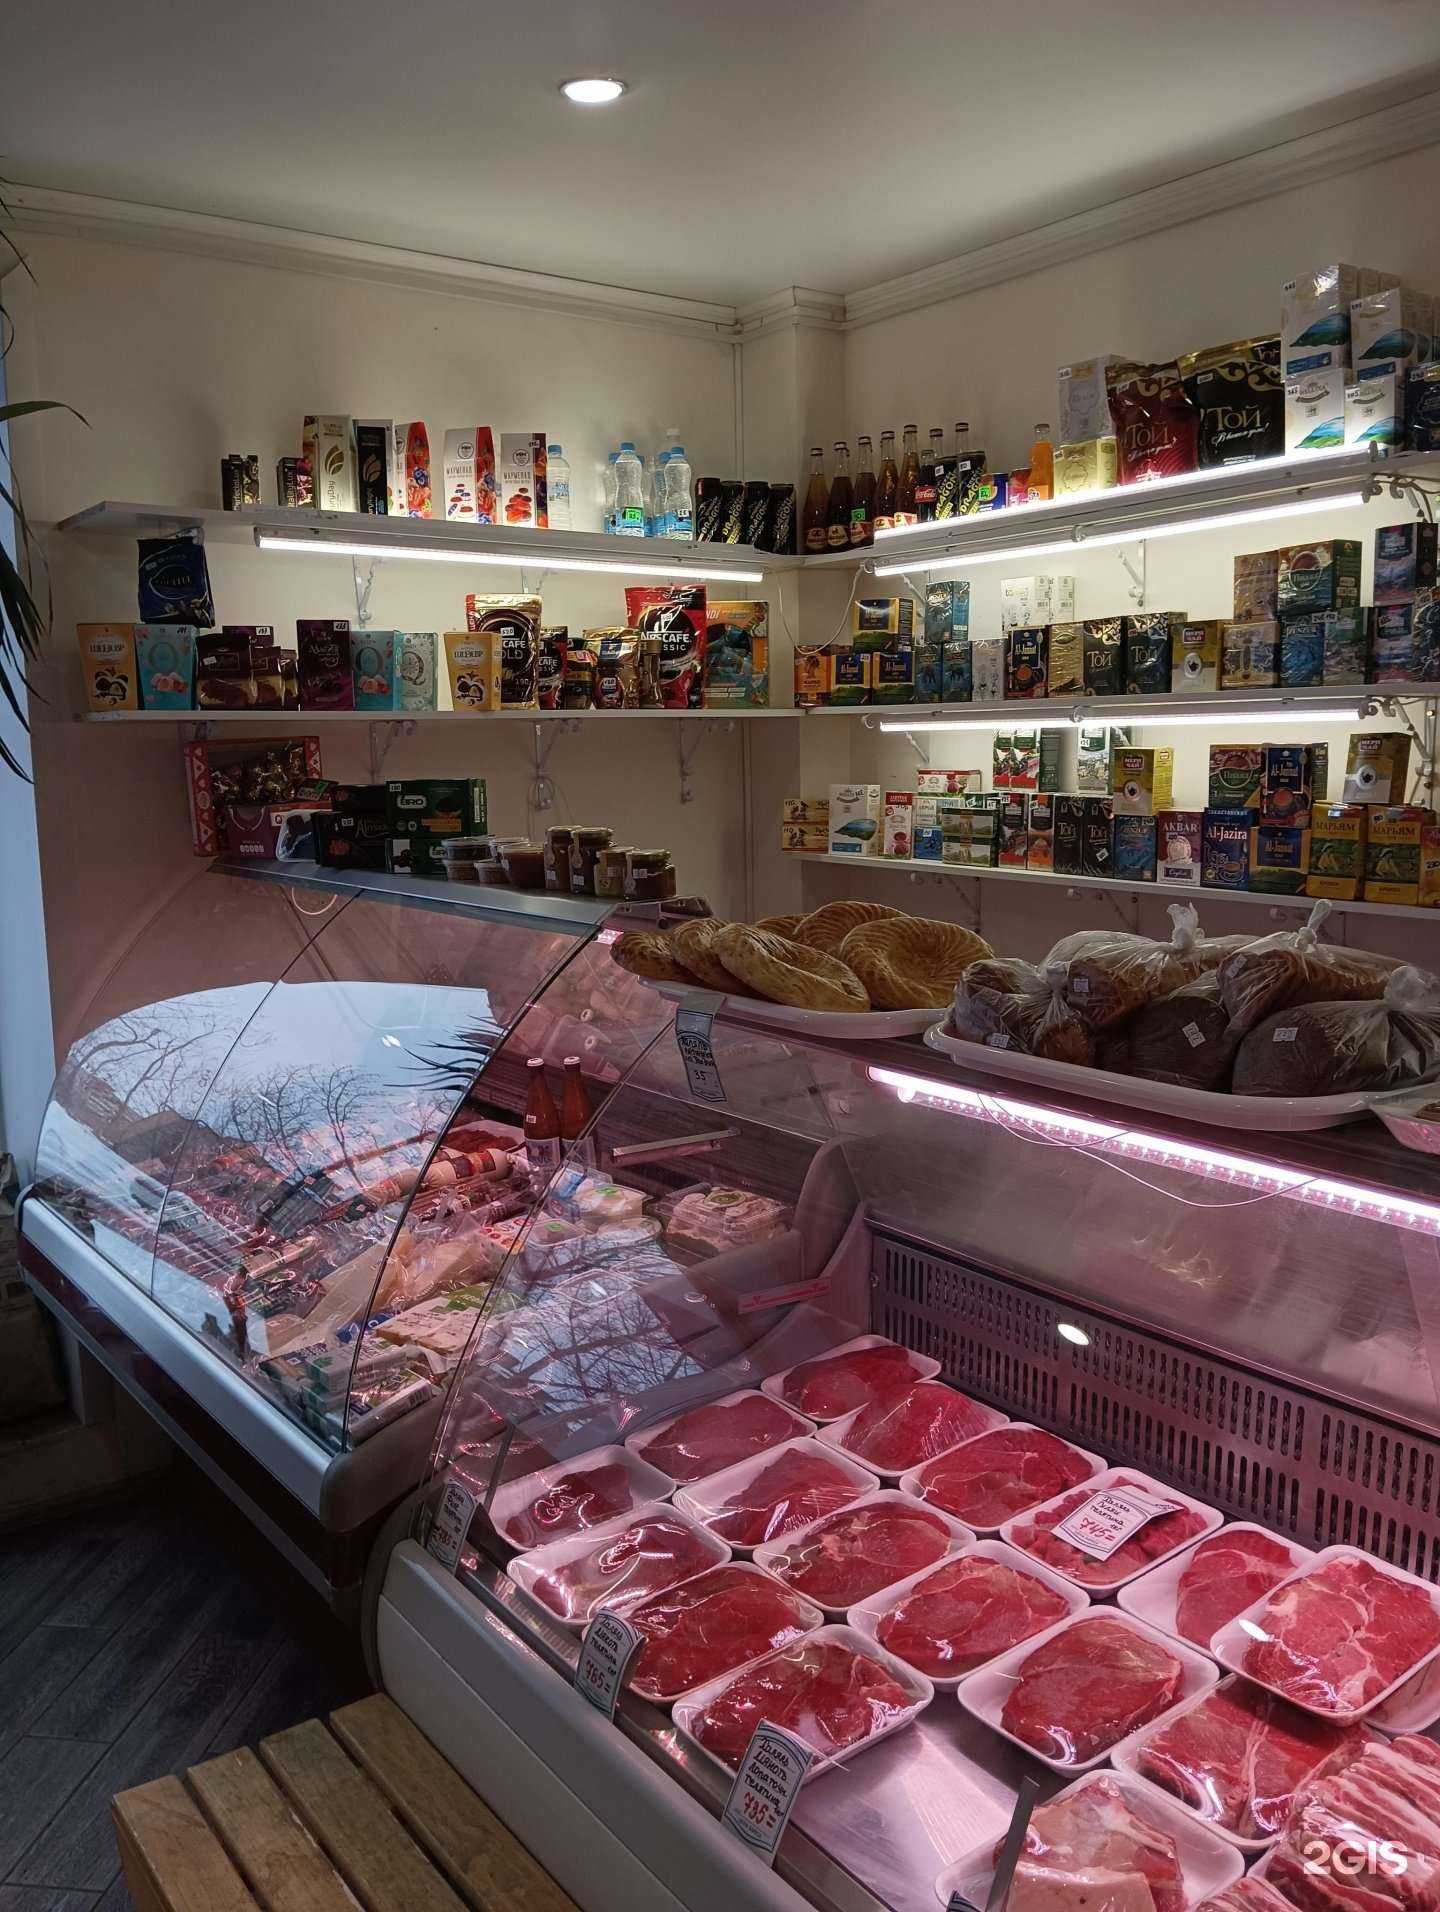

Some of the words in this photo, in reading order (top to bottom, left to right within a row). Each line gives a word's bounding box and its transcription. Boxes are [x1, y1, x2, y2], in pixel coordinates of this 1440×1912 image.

[1207, 404, 1262, 432] Той
[503, 639, 526, 649] CAFE
[1162, 822, 1199, 833] AKBAR
[1374, 826, 1415, 836] МАРЬЯМ
[1206, 826, 1247, 841] Al-Jazira
